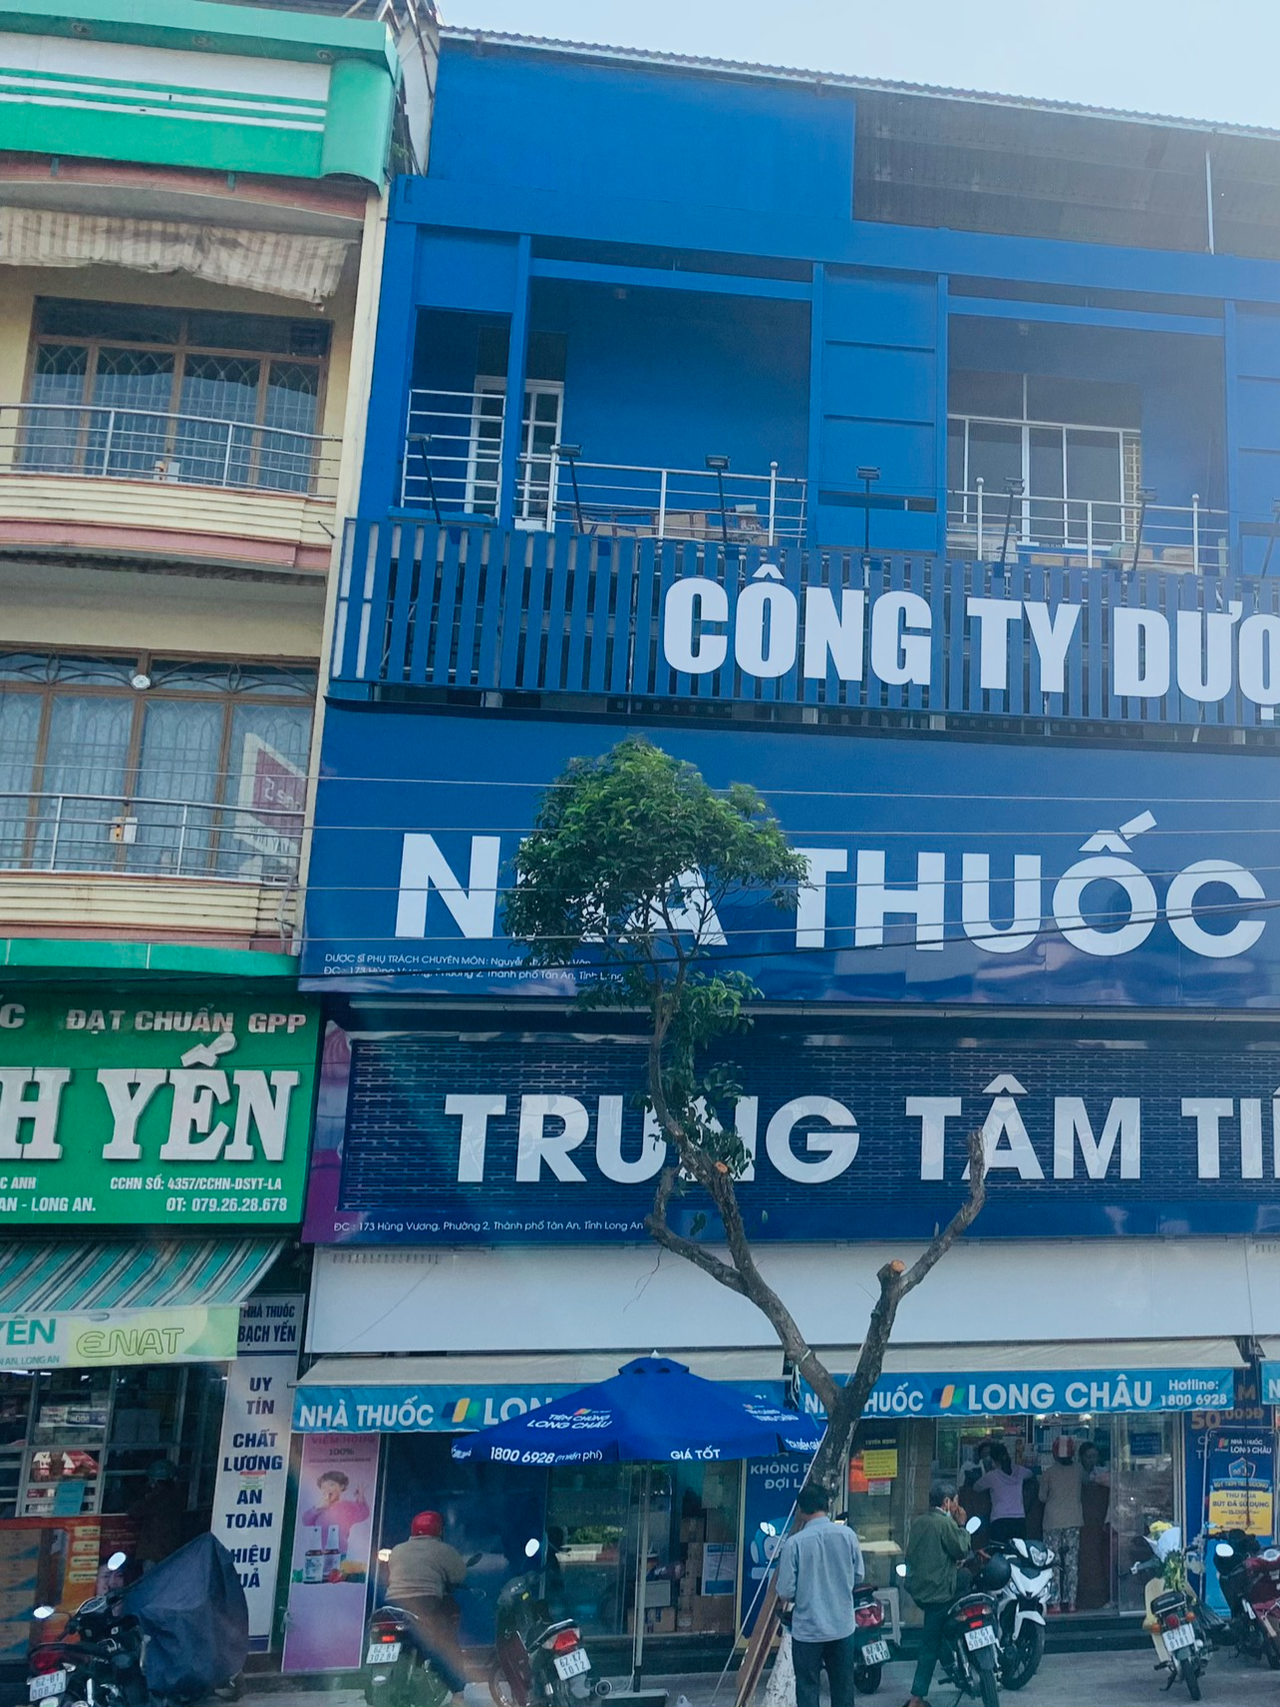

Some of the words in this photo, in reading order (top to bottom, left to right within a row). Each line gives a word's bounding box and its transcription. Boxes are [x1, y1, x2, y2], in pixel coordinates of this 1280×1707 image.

[663, 564, 931, 685] CÔNG
[967, 598, 1080, 693] TY
[795, 810, 1266, 957] THUỐC
[325, 953, 355, 963] DƯỢC
[367, 954, 386, 964] PHỤ
[388, 954, 419, 964] TRÁCH
[421, 955, 460, 965] CHUYÊN
[66, 1009, 126, 1035] ĐẠT
[135, 1004, 234, 1034] CHUẨN
[248, 1013, 306, 1034] GPP
[97, 1032, 299, 1161] YẾN
[444, 1093, 861, 1184] TRUNG
[906, 1073, 1141, 1182] TÂM
[10, 1177, 37, 1190] ANH
[110, 1177, 142, 1191] CCHN
[145, 1173, 165, 1190] SỐ:
[167, 1178, 283, 1191] 4357/CCHN-DSYT-LA
[31, 1197, 69, 1212] LONG
[72, 1197, 96, 1212] AN.
[191, 1198, 288, 1213] 079.26.28.678
[358, 1222, 375, 1231] 173
[377, 1221, 403, 1233] Hùng
[405, 1221, 440, 1233] Vương,
[443, 1220, 480, 1233] Phường
[494, 1220, 522, 1231] Thành
[524, 1219, 545, 1233] phố
[547, 1220, 563, 1231] Tân
[565, 1221, 582, 1232] An,
[584, 1219, 602, 1231] Tỉnh
[604, 1221, 628, 1233] Long
[630, 1222, 644, 1231] An
[243, 1303, 262, 1318] NHÀ
[265, 1301, 295, 1318] THUỐC
[237, 1325, 270, 1347] BẠCH
[273, 1320, 297, 1343] YẾN
[21, 1355, 46, 1365] LONG
[47, 1355, 60, 1364] AN
[249, 1376, 272, 1392] UY
[1169, 1379, 1219, 1391] Hotline:
[864, 1382, 924, 1412] HUỐC
[968, 1382, 1057, 1412] LONG
[1064, 1374, 1152, 1409] CHÂU
[1160, 1395, 1192, 1406] 1800
[1195, 1393, 1227, 1406] 6928
[246, 1396, 274, 1415] TÍN
[299, 1398, 348, 1429] NHÀ
[355, 1394, 434, 1428] THUỐC
[527, 1419, 570, 1429] LONG
[571, 1420, 613, 1429] CHÂU
[232, 1428, 278, 1449] CHẤT
[329, 1447, 355, 1456] 100%
[491, 1446, 520, 1462] 1800
[522, 1450, 556, 1464] 6928
[583, 1449, 603, 1462] phí)
[670, 1447, 693, 1460] GIÁ
[695, 1445, 720, 1459] TỐT
[1252, 1445, 1272, 1455] CHÂU
[751, 1461, 799, 1475] KHÔNG
[764, 1477, 790, 1492] ĐỢI
[236, 1489, 262, 1505] AN
[1249, 1501, 1270, 1509] DỤNG
[226, 1510, 272, 1529] TOÀN
[233, 1545, 271, 1566] HIỆU
